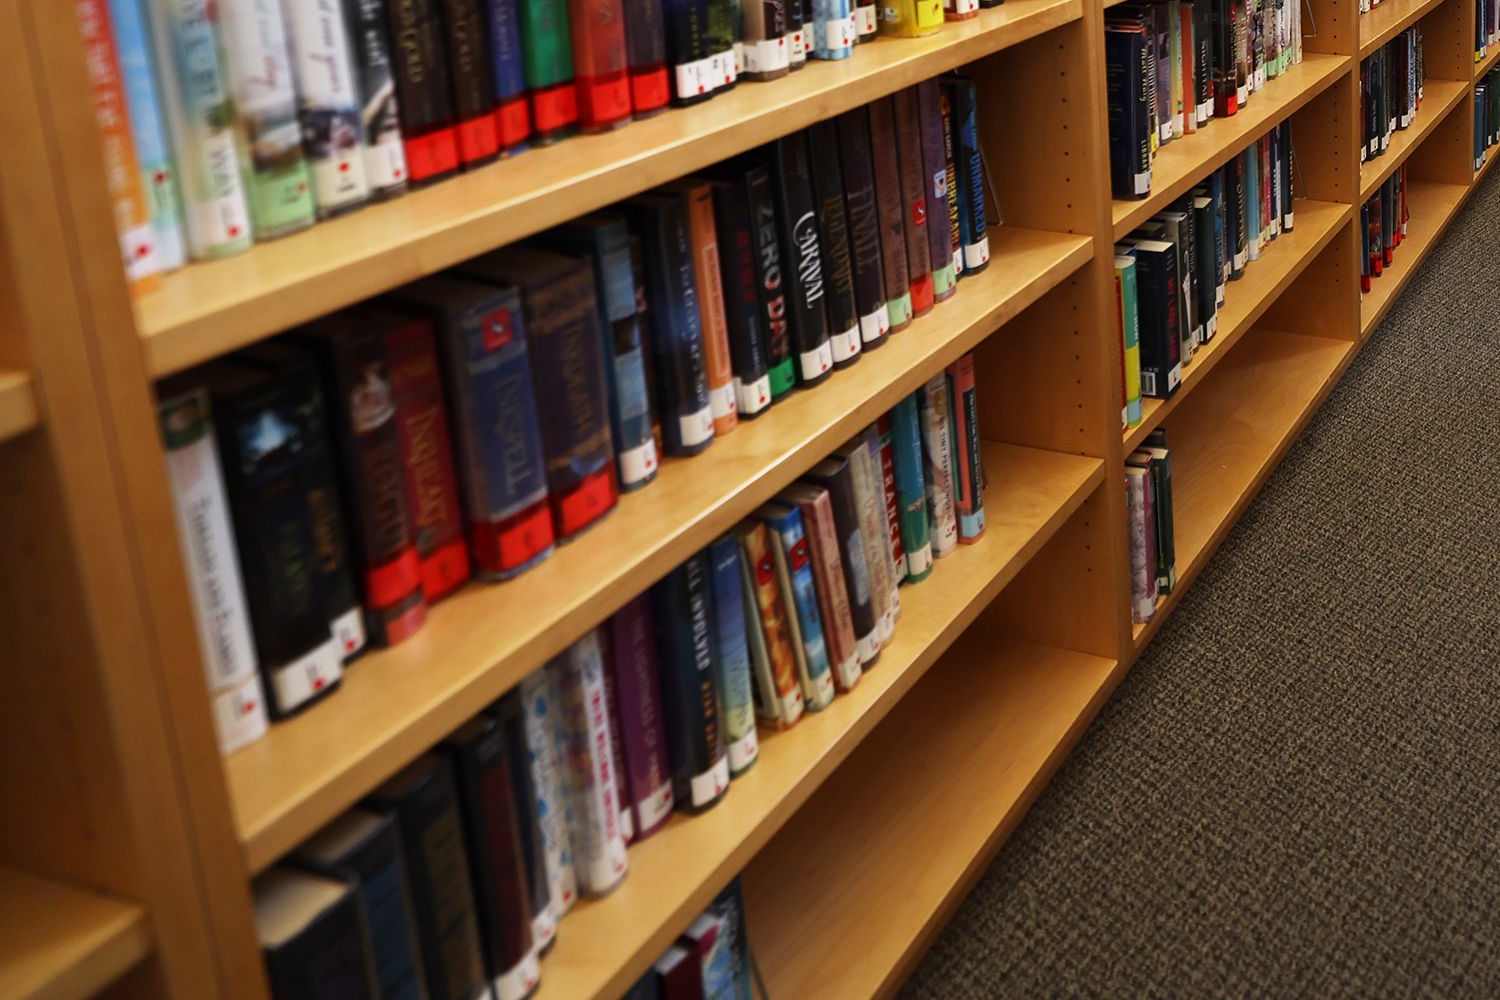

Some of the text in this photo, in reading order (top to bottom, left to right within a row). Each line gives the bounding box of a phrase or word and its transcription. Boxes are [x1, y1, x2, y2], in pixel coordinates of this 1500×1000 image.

[969, 152, 987, 235] UNMARKED
[1140, 139, 1150, 173] LIBRAR
[759, 203, 791, 356] ZERO DAY
[792, 210, 825, 309] CARAVAL
